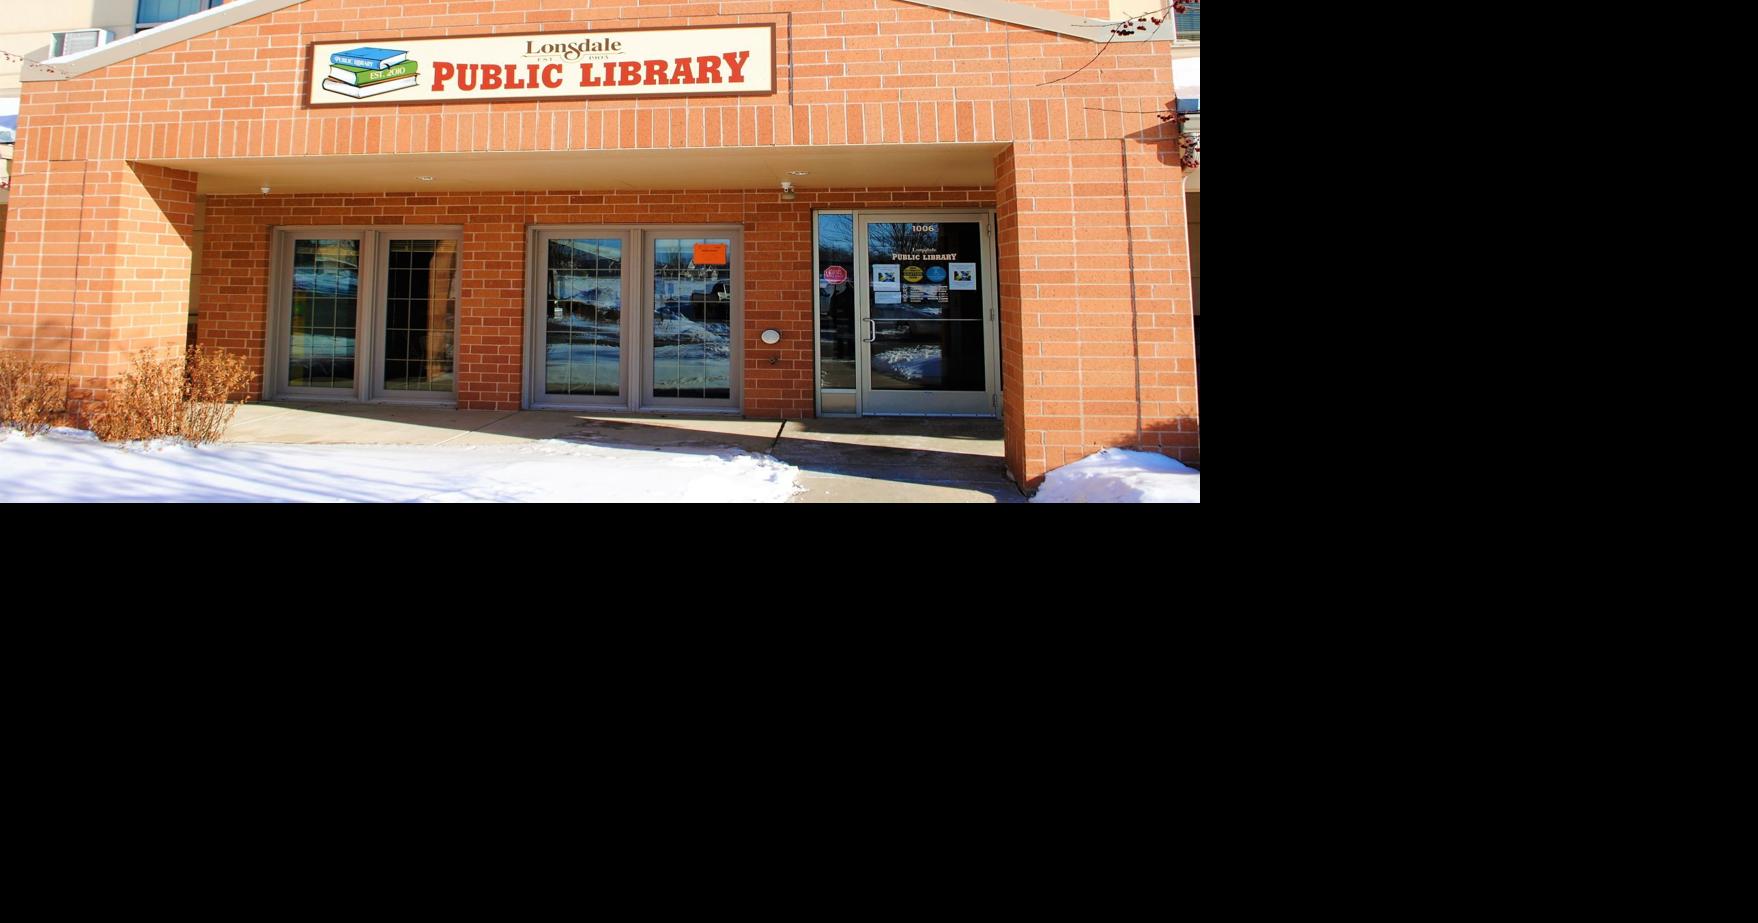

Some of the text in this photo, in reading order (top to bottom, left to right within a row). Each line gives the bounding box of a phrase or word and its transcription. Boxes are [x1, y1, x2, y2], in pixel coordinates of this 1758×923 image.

[526, 38, 622, 61] Lonsdale
[369, 67, 406, 80] EST. 2010
[431, 51, 750, 92] PUBLIC LIBRARY
[892, 253, 957, 261] PUBLIC LIBRARY
